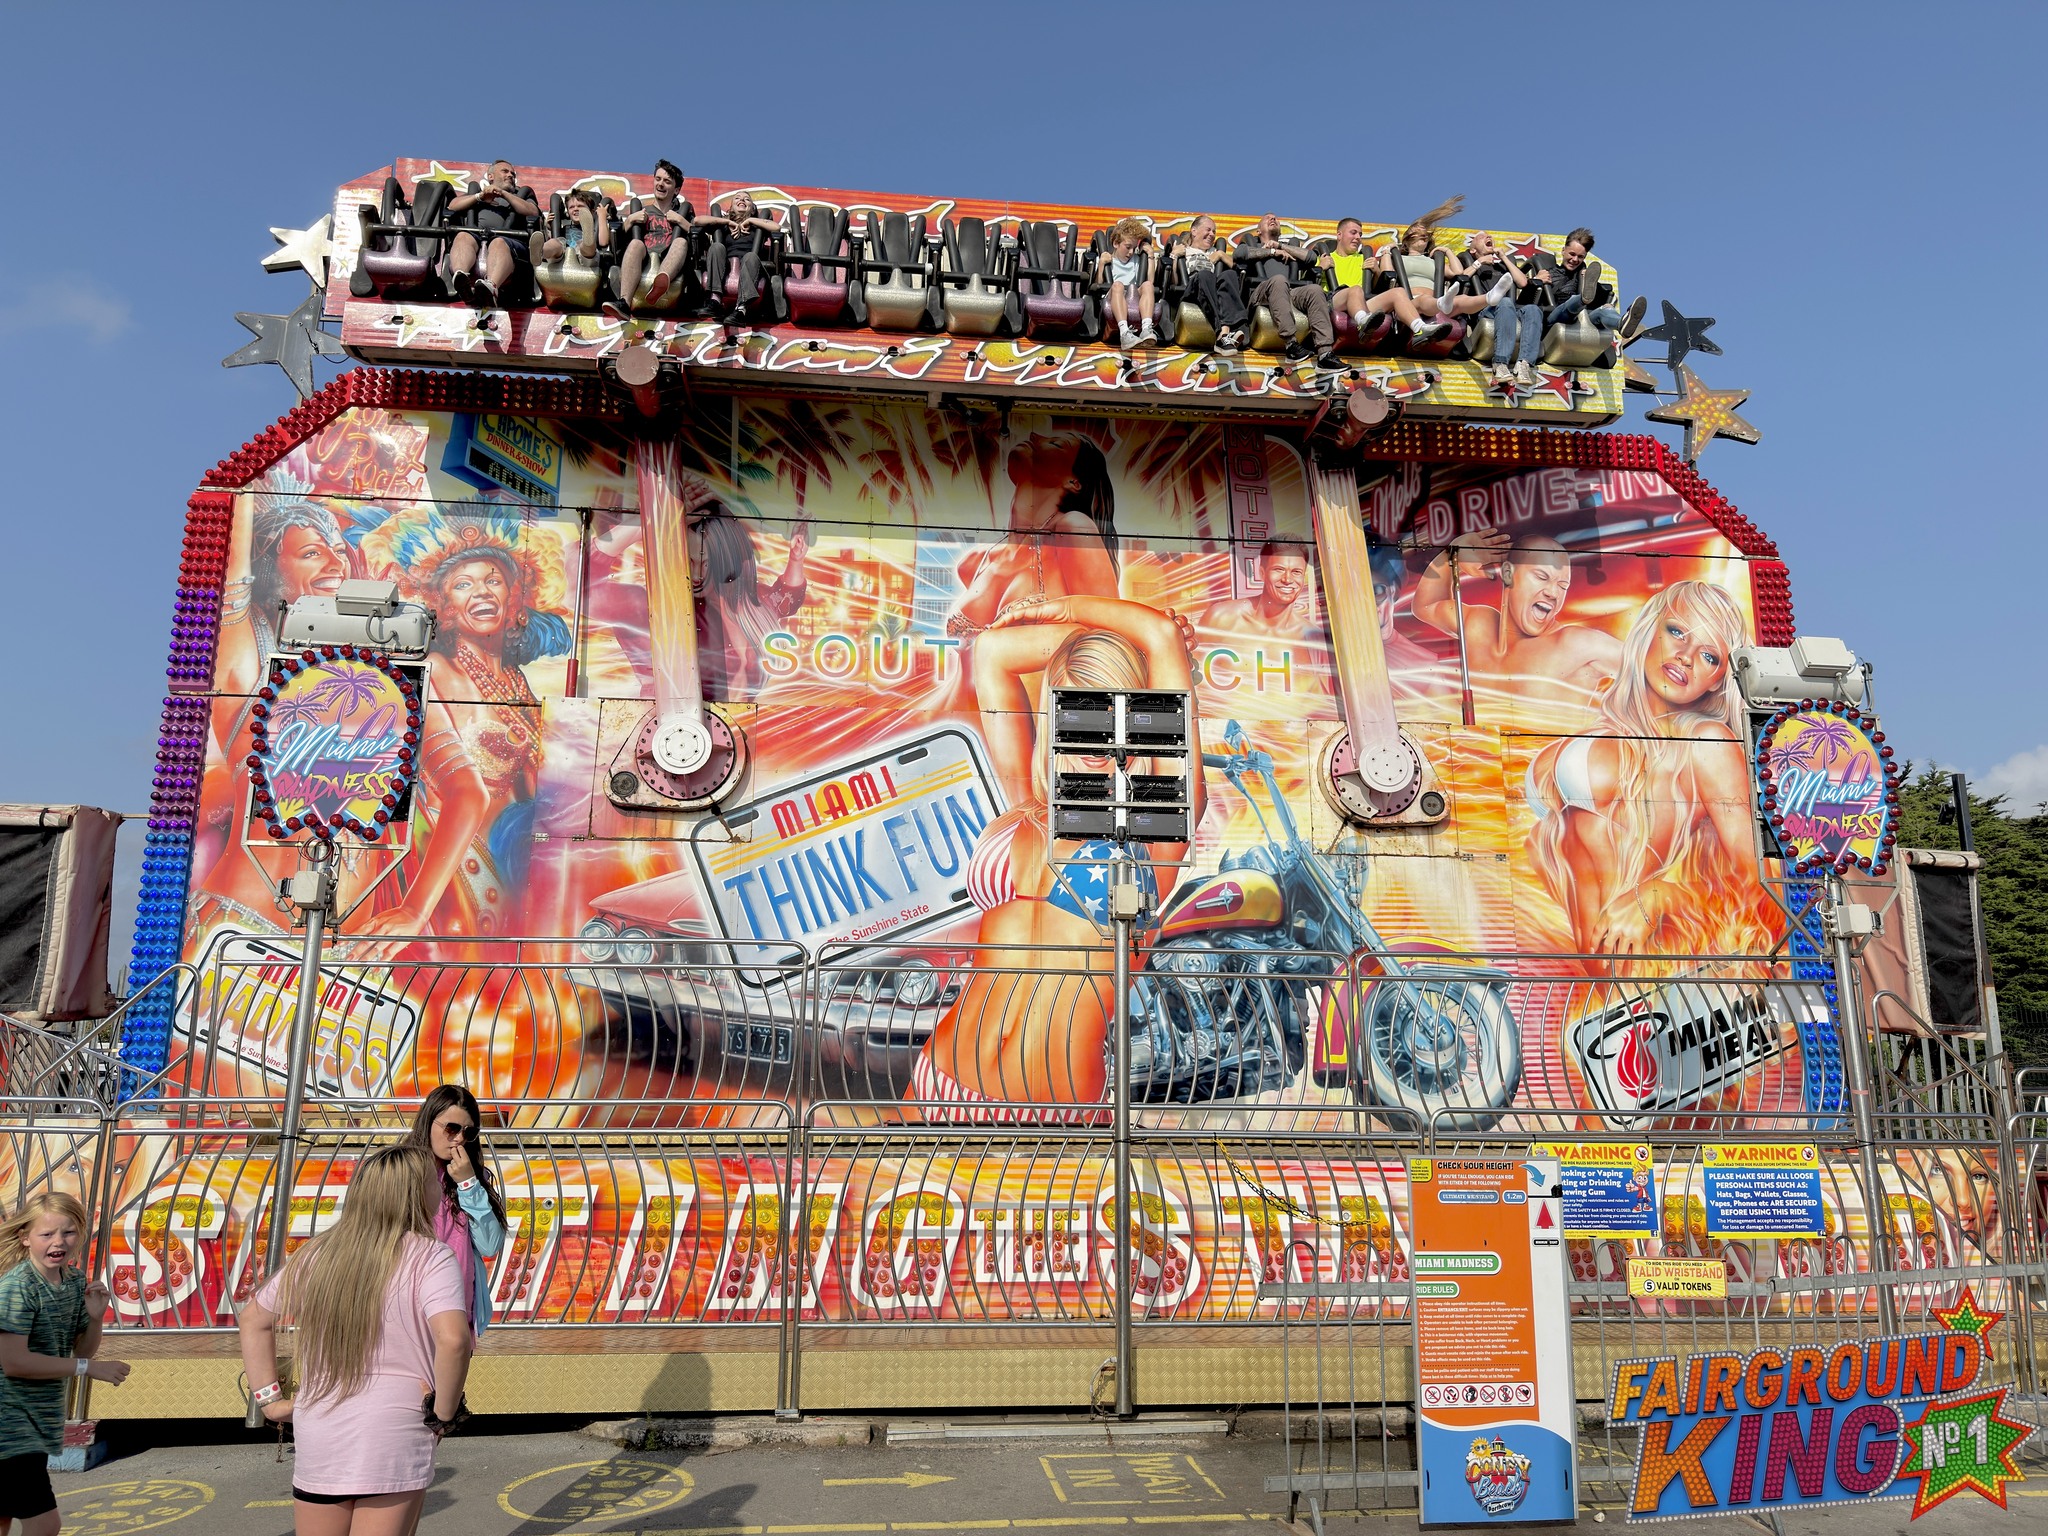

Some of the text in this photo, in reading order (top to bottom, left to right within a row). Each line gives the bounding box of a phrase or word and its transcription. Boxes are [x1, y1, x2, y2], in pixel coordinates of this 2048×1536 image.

[1228, 424, 1268, 590] MOTEL
[762, 633, 961, 682] SOUT
[273, 720, 400, 776] Miami
[274, 771, 395, 812] MADNESS
[770, 765, 899, 840] MIAMI
[1777, 767, 1878, 818] Miami
[1783, 813, 1882, 848] MADNESS
[724, 788, 988, 955] THINK FUN
[851, 919, 899, 941] Sunshine
[900, 904, 930, 921] State
[256, 954, 362, 1016] MIMI
[1438, 1162, 1513, 1170] CHECK YOUR HEIGHT!
[1553, 1146, 1631, 1159] WARNING
[1722, 1148, 1797, 1160] WARNING
[1561, 1170, 1586, 1178] moking
[1597, 1170, 1623, 1178] Vaping
[1710, 1200, 1732, 1208] Vapes,
[1735, 1191, 1752, 1199] Bags,
[969, 1200, 1088, 1282] THE
[1415, 1259, 1493, 1267] MIAMI MADNESS
[1632, 1265, 1722, 1279] VALID WRISTBAND
[1656, 1282, 1679, 1290] VALID
[1681, 1282, 1711, 1290] TOKENS
[1611, 1333, 1982, 1421] FAIRGROUND
[1466, 1456, 1531, 1482] CONEY
[1632, 1403, 1900, 1514] KING
[588, 1466, 677, 1484] STAY
[1476, 1476, 1522, 1498] Beach
[108, 1485, 198, 1501] STAY
[564, 1489, 673, 1517] SAFE
